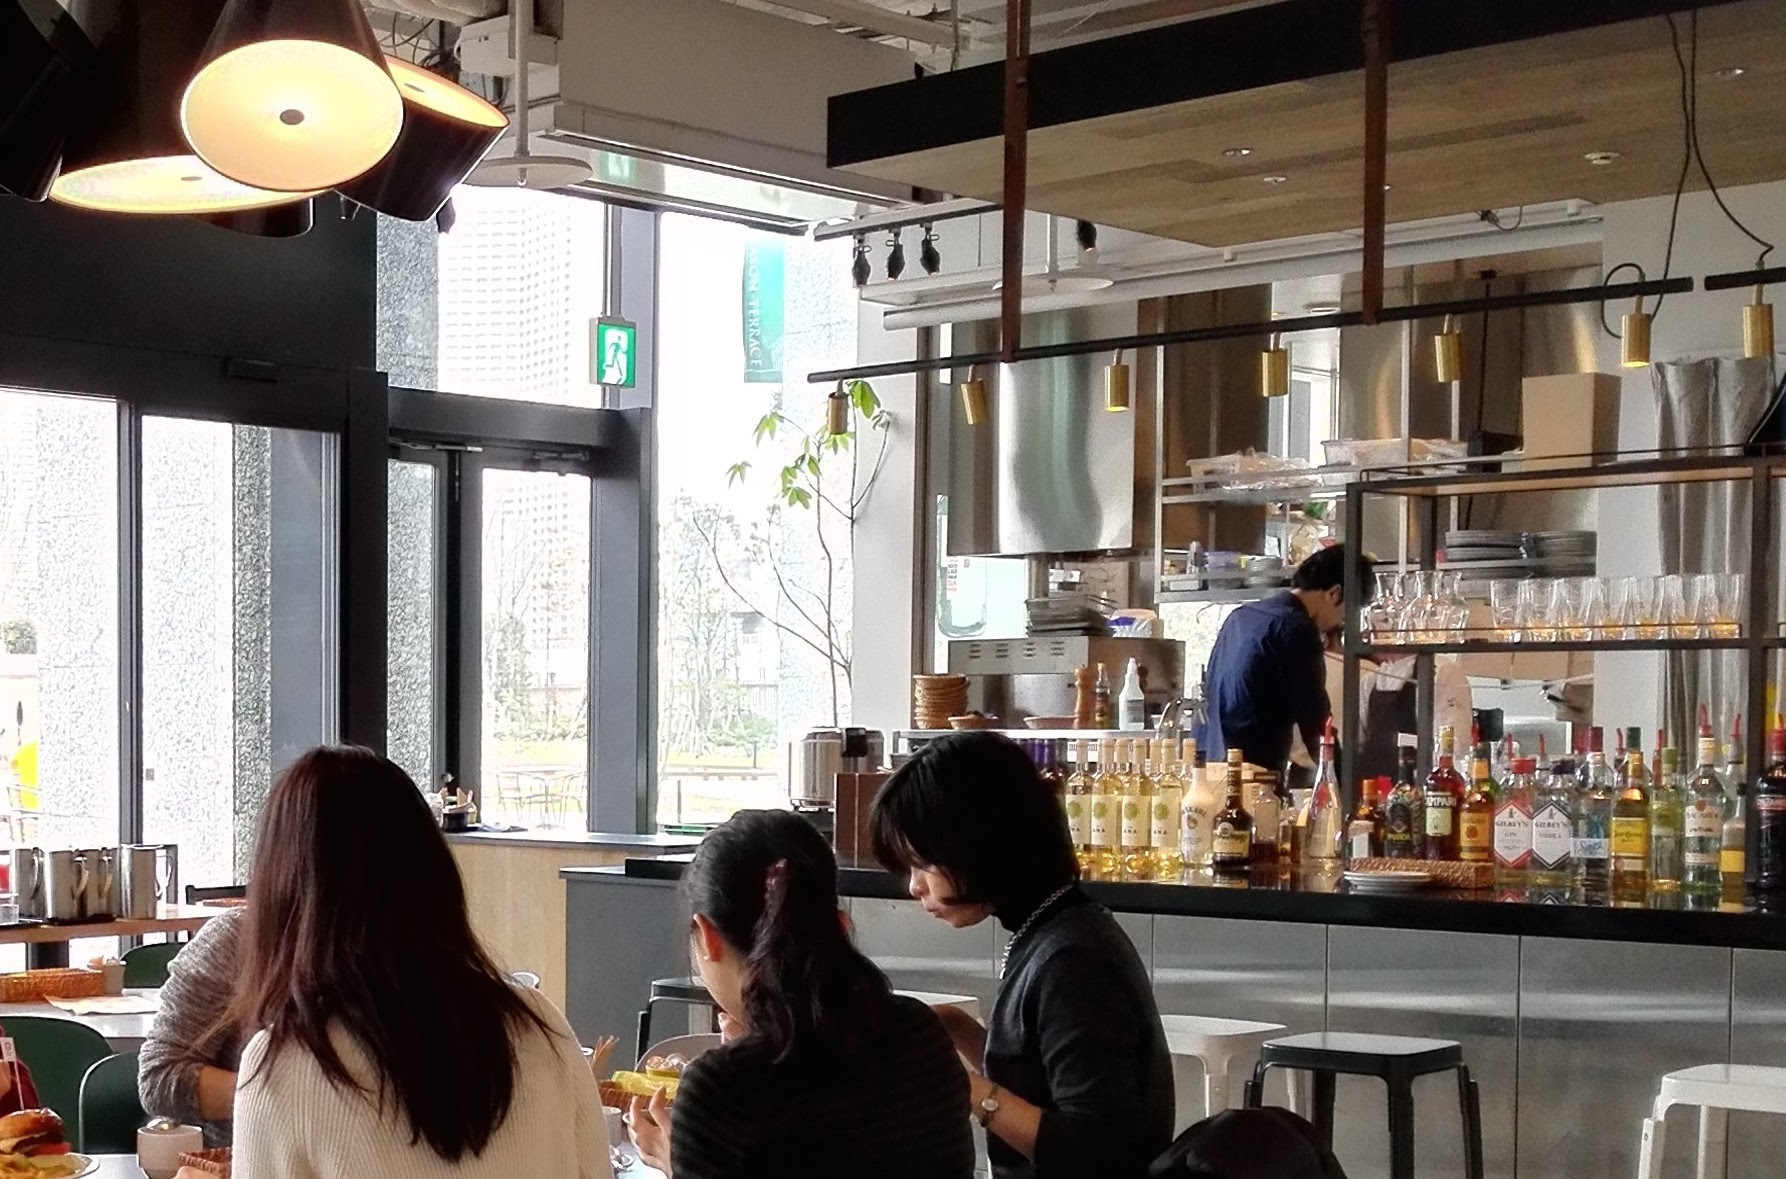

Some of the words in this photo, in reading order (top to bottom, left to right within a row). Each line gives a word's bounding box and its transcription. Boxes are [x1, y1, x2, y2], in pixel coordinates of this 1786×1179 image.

[748, 299, 762, 366] TERRACE
[1425, 796, 1457, 807] AMPARI
[1496, 820, 1528, 828] GILBEY'S
